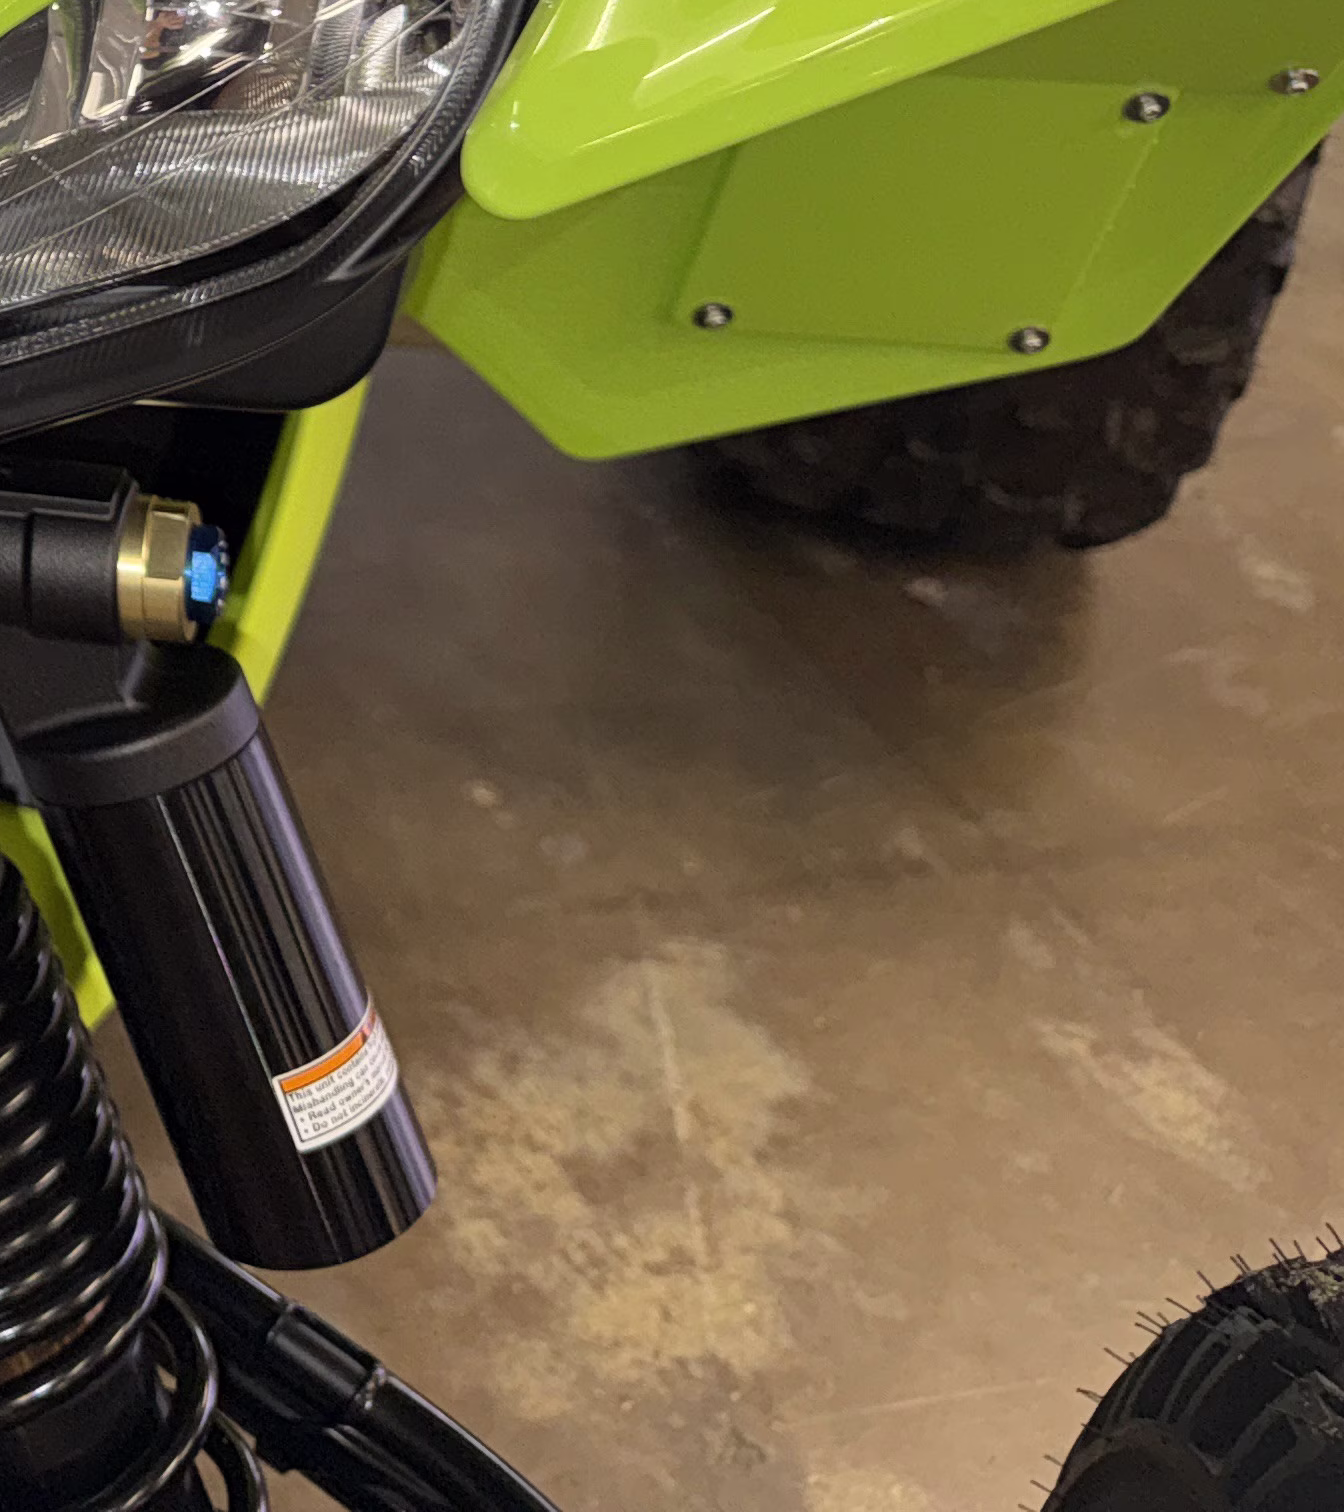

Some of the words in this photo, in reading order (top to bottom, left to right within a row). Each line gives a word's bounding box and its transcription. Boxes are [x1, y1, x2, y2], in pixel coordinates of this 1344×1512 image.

[289, 1088, 313, 1103] This
[314, 1074, 336, 1092] unit
[292, 1077, 355, 1113] Mishandling
[307, 1101, 337, 1121] Read
[312, 1120, 329, 1132] Do
[330, 1107, 348, 1125] not
